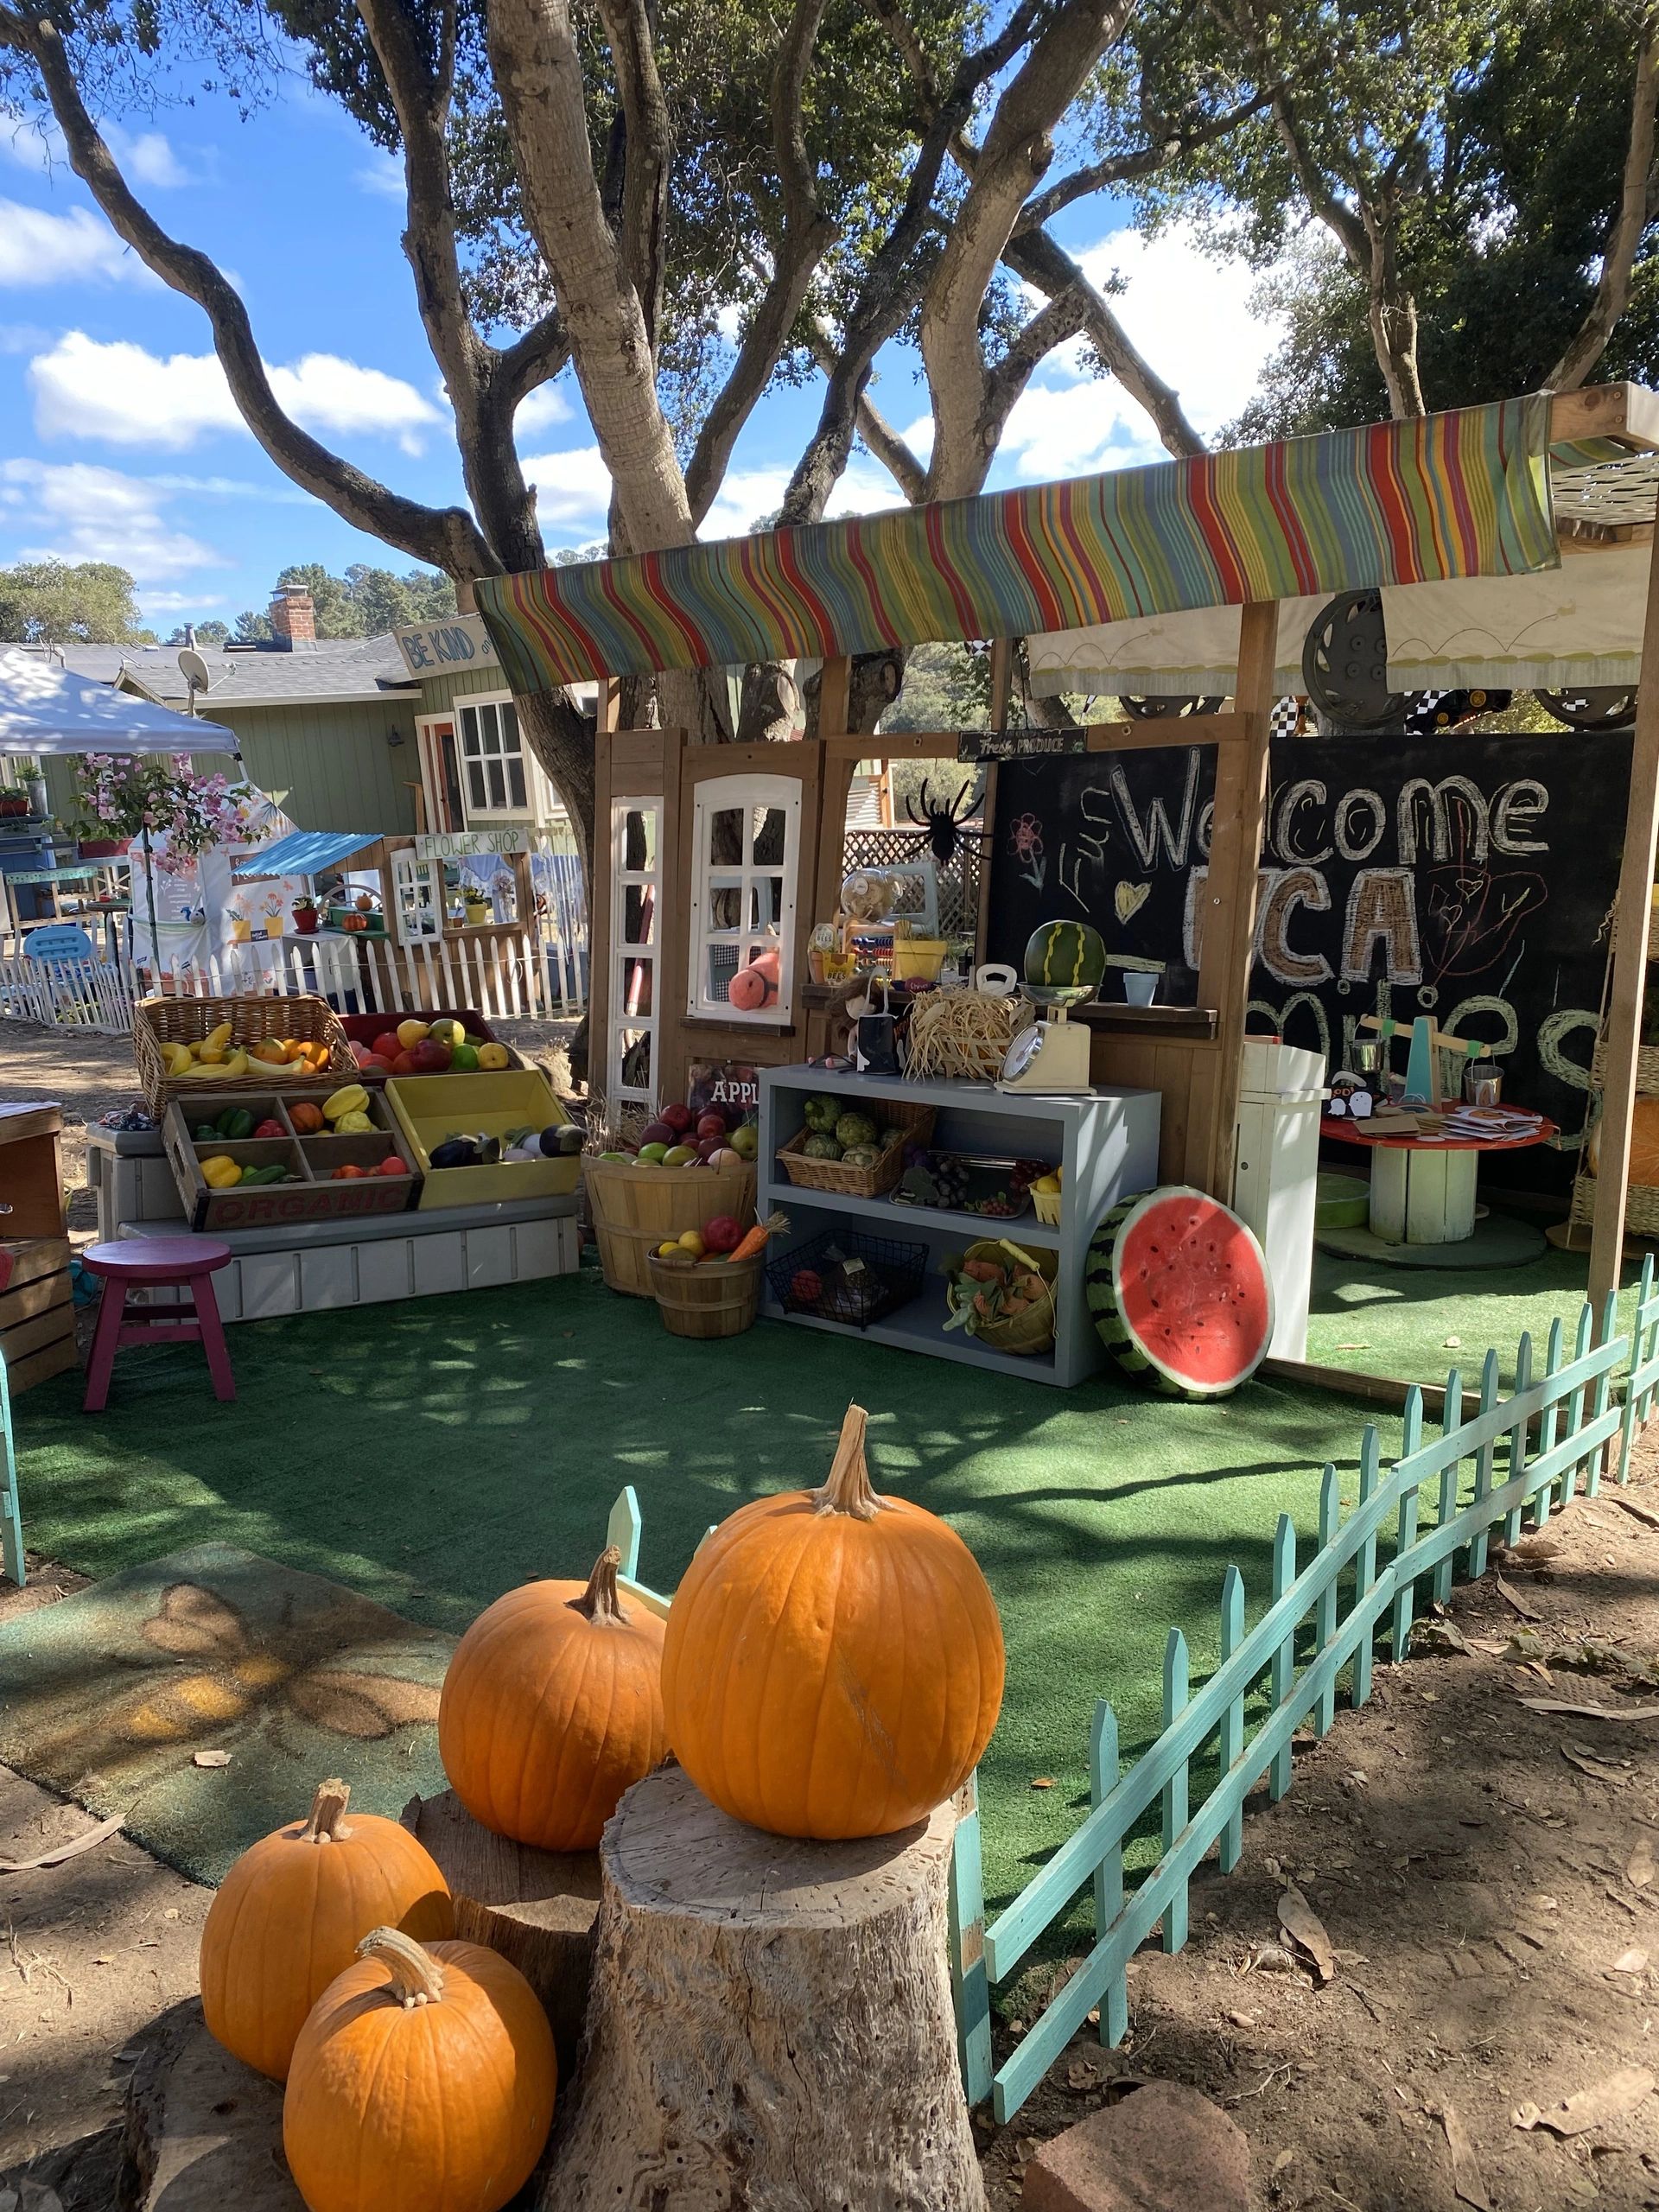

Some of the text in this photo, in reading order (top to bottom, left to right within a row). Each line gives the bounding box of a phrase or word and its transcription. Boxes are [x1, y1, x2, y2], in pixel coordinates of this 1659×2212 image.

[402, 633, 435, 669] BE
[428, 626, 474, 663] KIND
[979, 737, 1065, 754] Fresh PRODUCE
[1109, 747, 1549, 874] Wcome
[424, 830, 518, 857] FLOWER SHOP
[827, 971, 846, 980] BEES
[217, 1187, 403, 1224] ORGANIC
